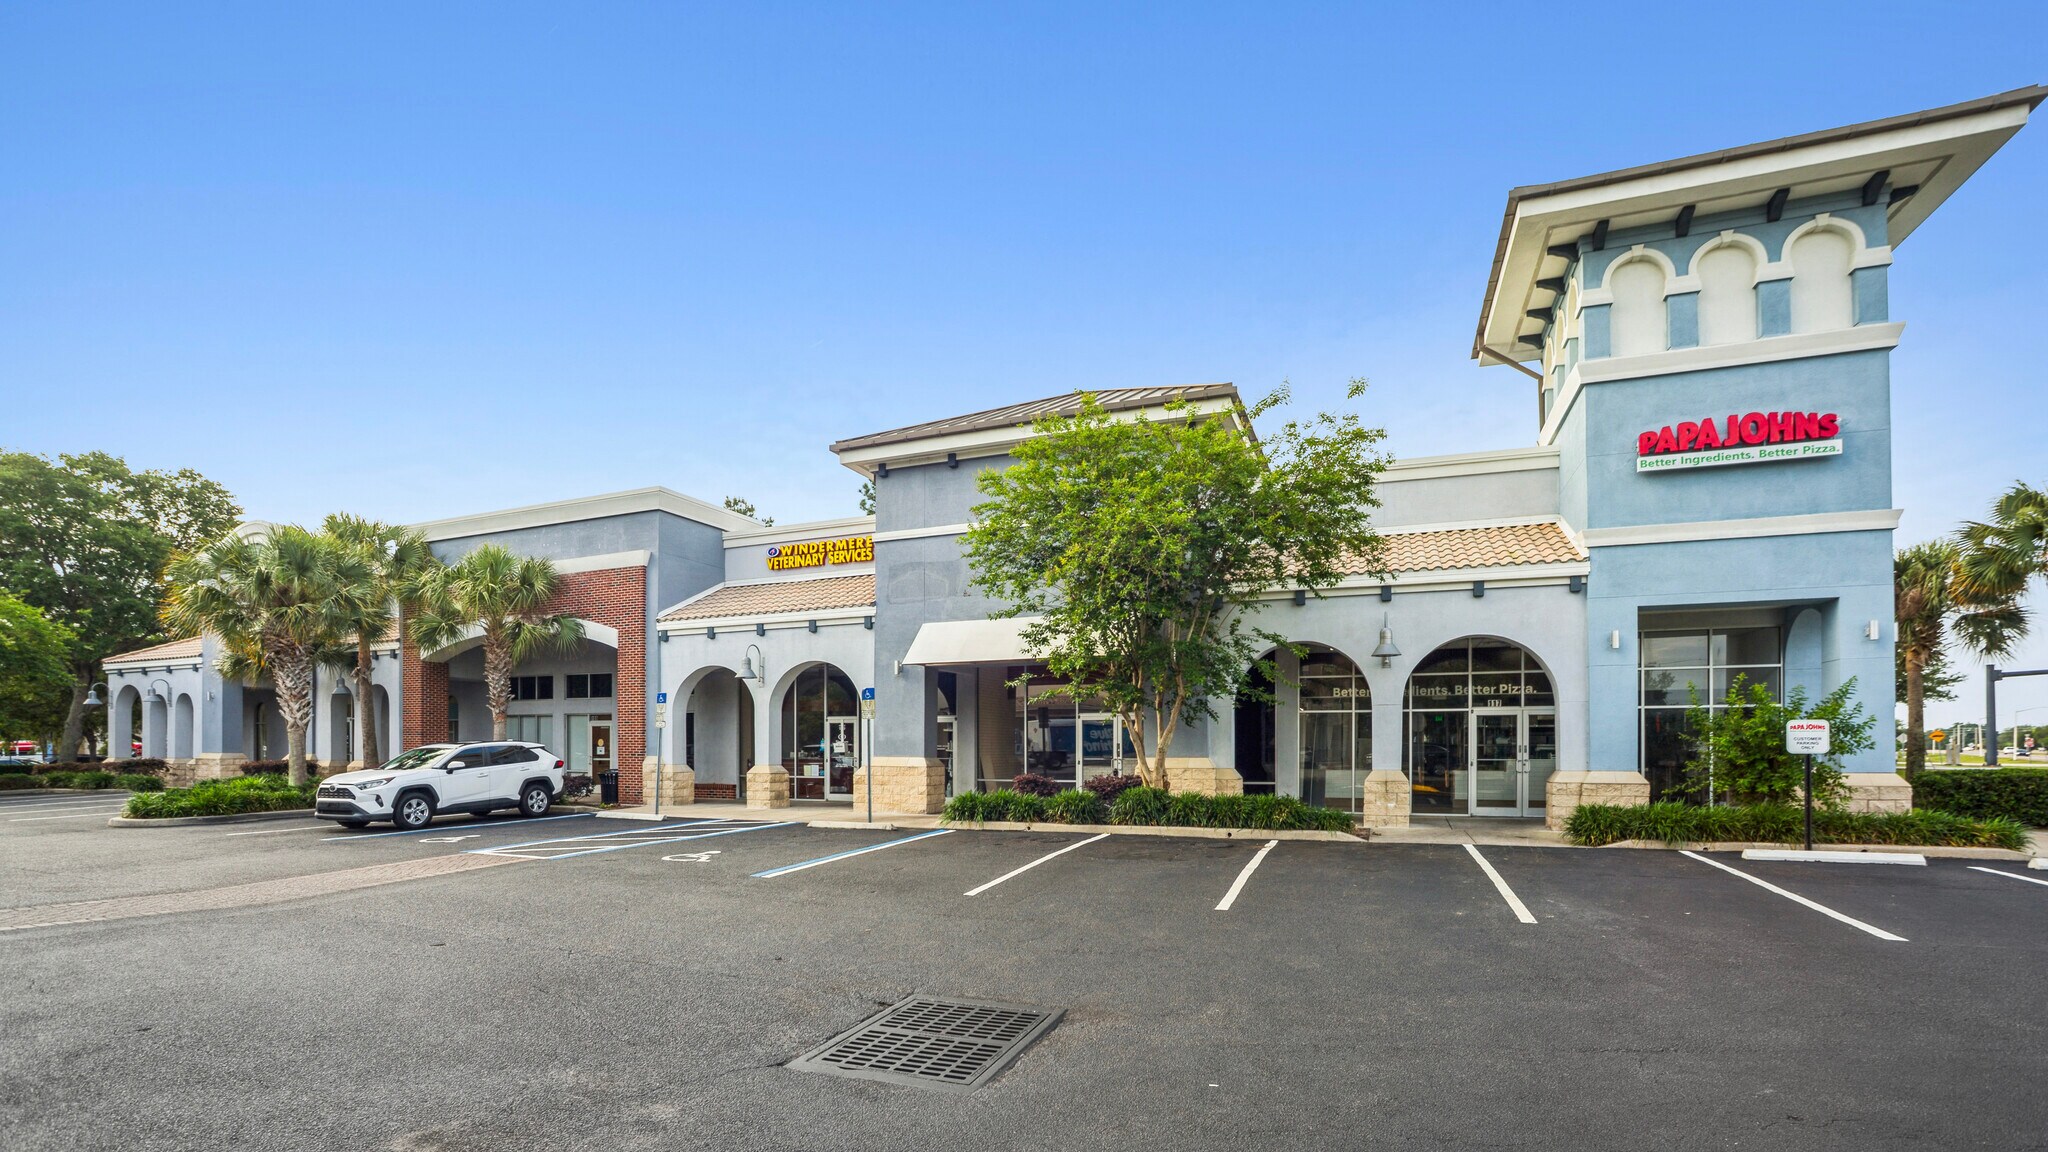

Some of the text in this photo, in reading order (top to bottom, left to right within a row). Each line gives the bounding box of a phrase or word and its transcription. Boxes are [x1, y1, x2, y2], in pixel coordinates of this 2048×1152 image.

[1638, 411, 1840, 456] PAPA JOHNS
[1640, 443, 1841, 469] Better Ingredients. Better Pizza.
[780, 536, 873, 556] WINDERMERE
[767, 548, 873, 570] VETERINARY SERVICES
[1454, 684, 1497, 696] Better
